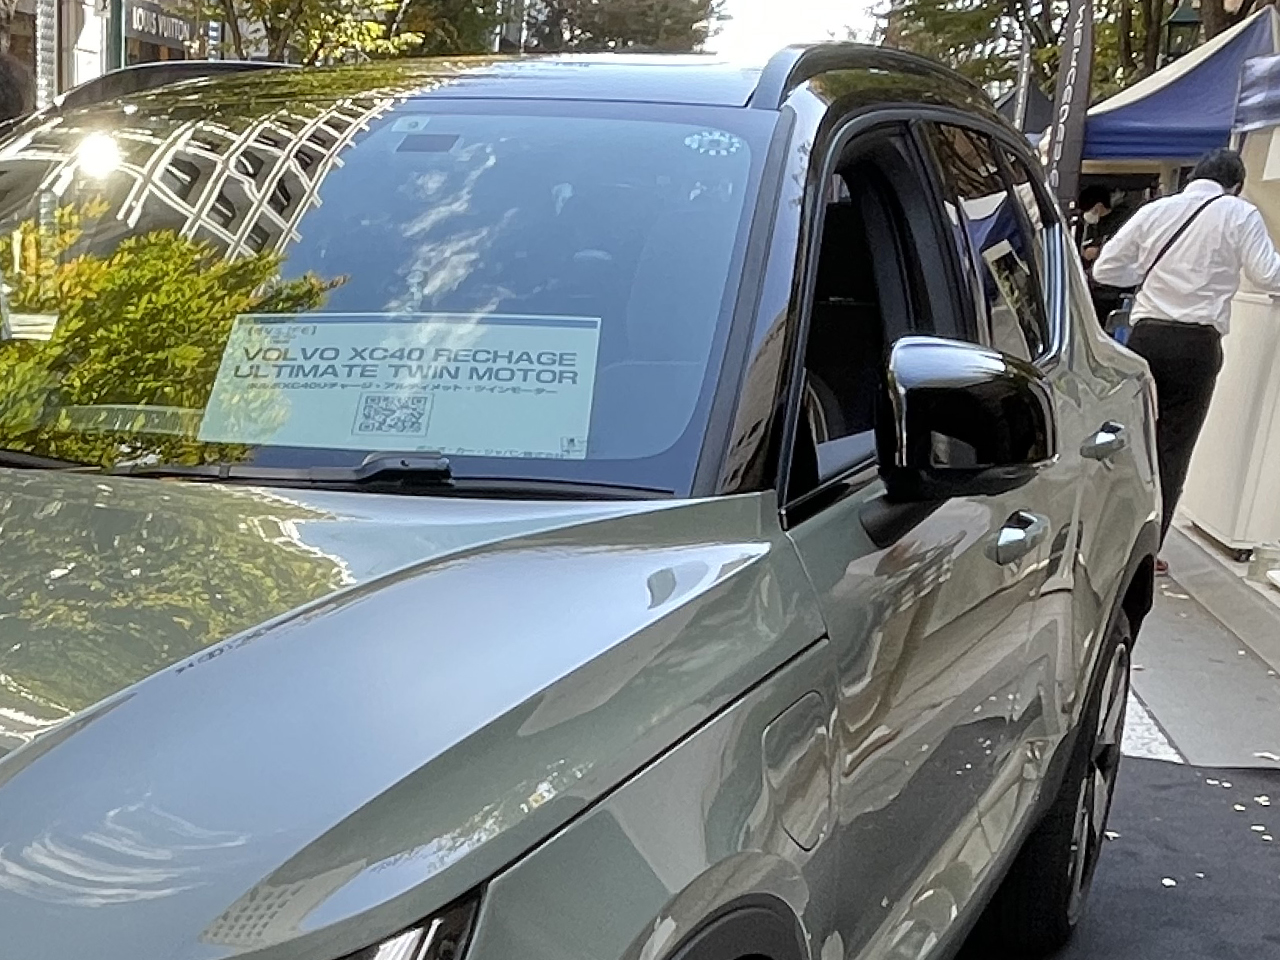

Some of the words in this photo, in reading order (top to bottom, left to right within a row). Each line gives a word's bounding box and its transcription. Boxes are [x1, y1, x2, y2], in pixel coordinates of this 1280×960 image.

[132, 6, 157, 35] LOUIS
[244, 347, 340, 362] VOLVO
[350, 347, 425, 363] XC40
[432, 348, 578, 367] RECHAGE
[233, 363, 378, 379] ULTIMATE
[389, 364, 461, 381] TWIN
[468, 367, 579, 385] MOTOR
